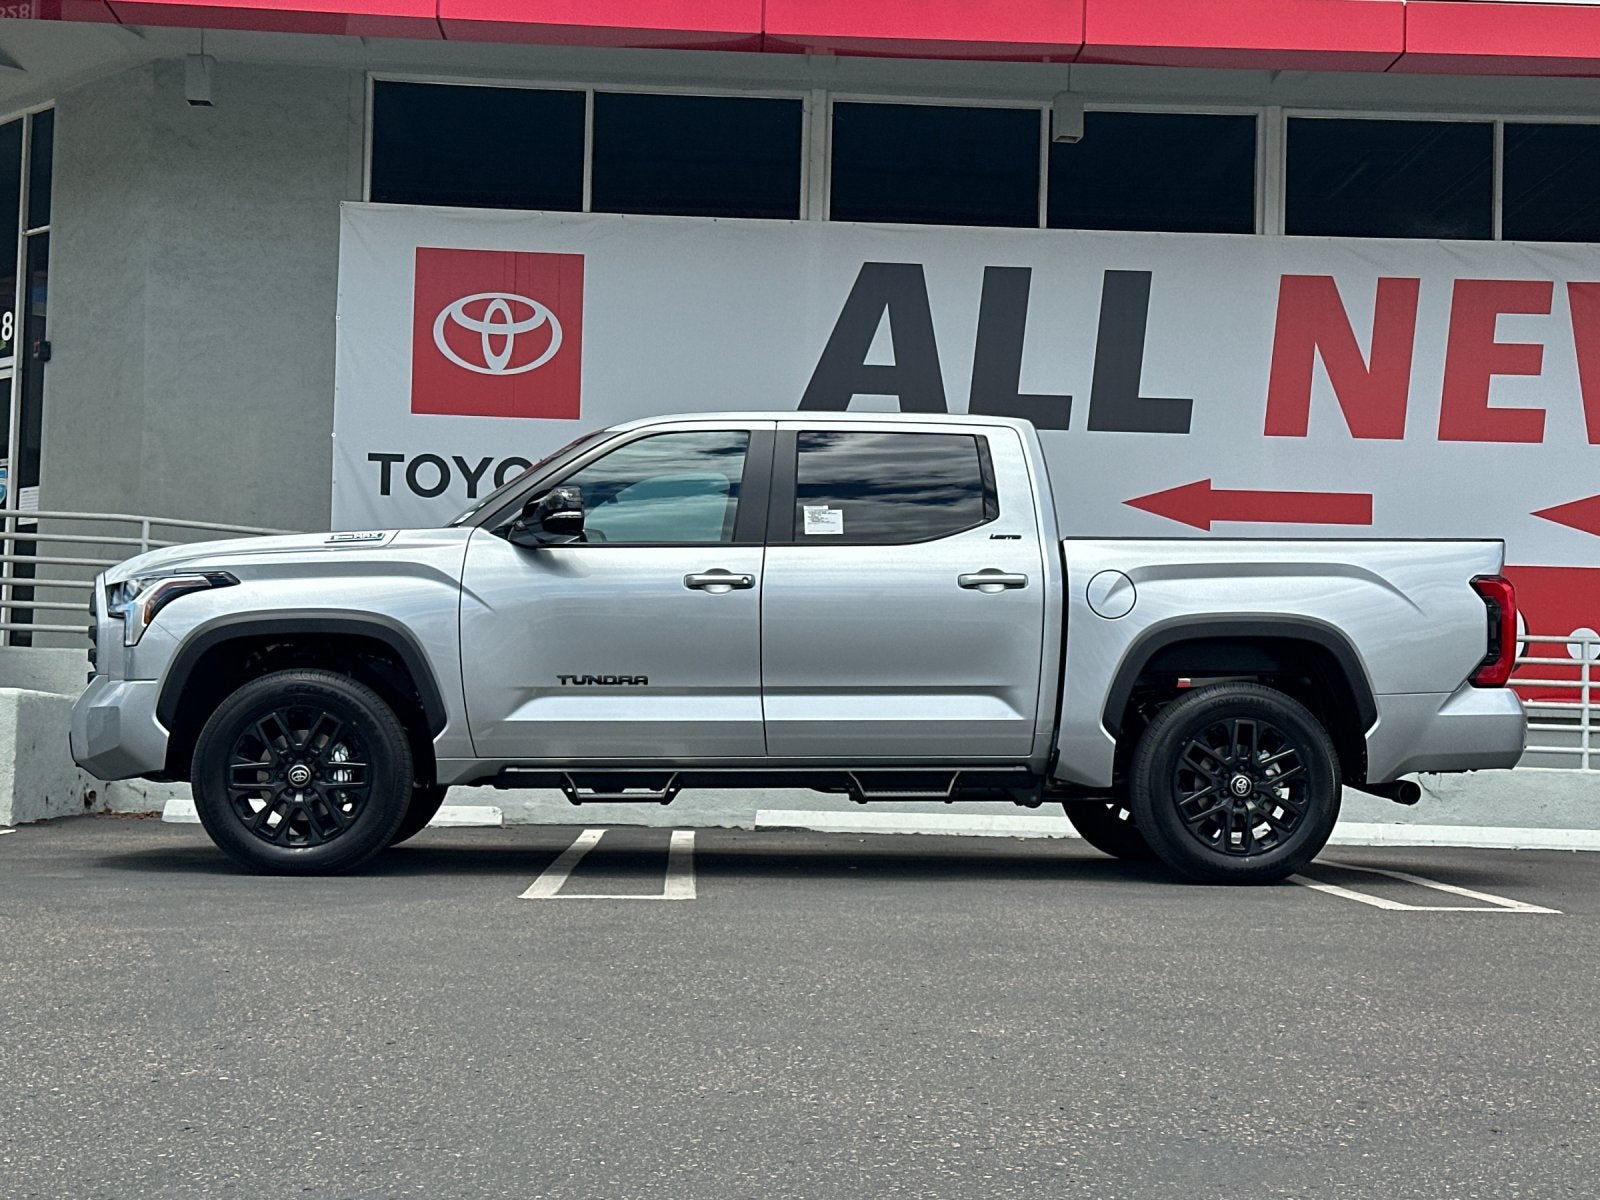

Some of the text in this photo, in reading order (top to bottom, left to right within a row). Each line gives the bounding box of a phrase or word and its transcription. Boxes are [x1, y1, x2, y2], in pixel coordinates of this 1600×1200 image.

[797, 262, 1600, 445] ALL NE
[556, 674, 649, 686] TUNDRA
